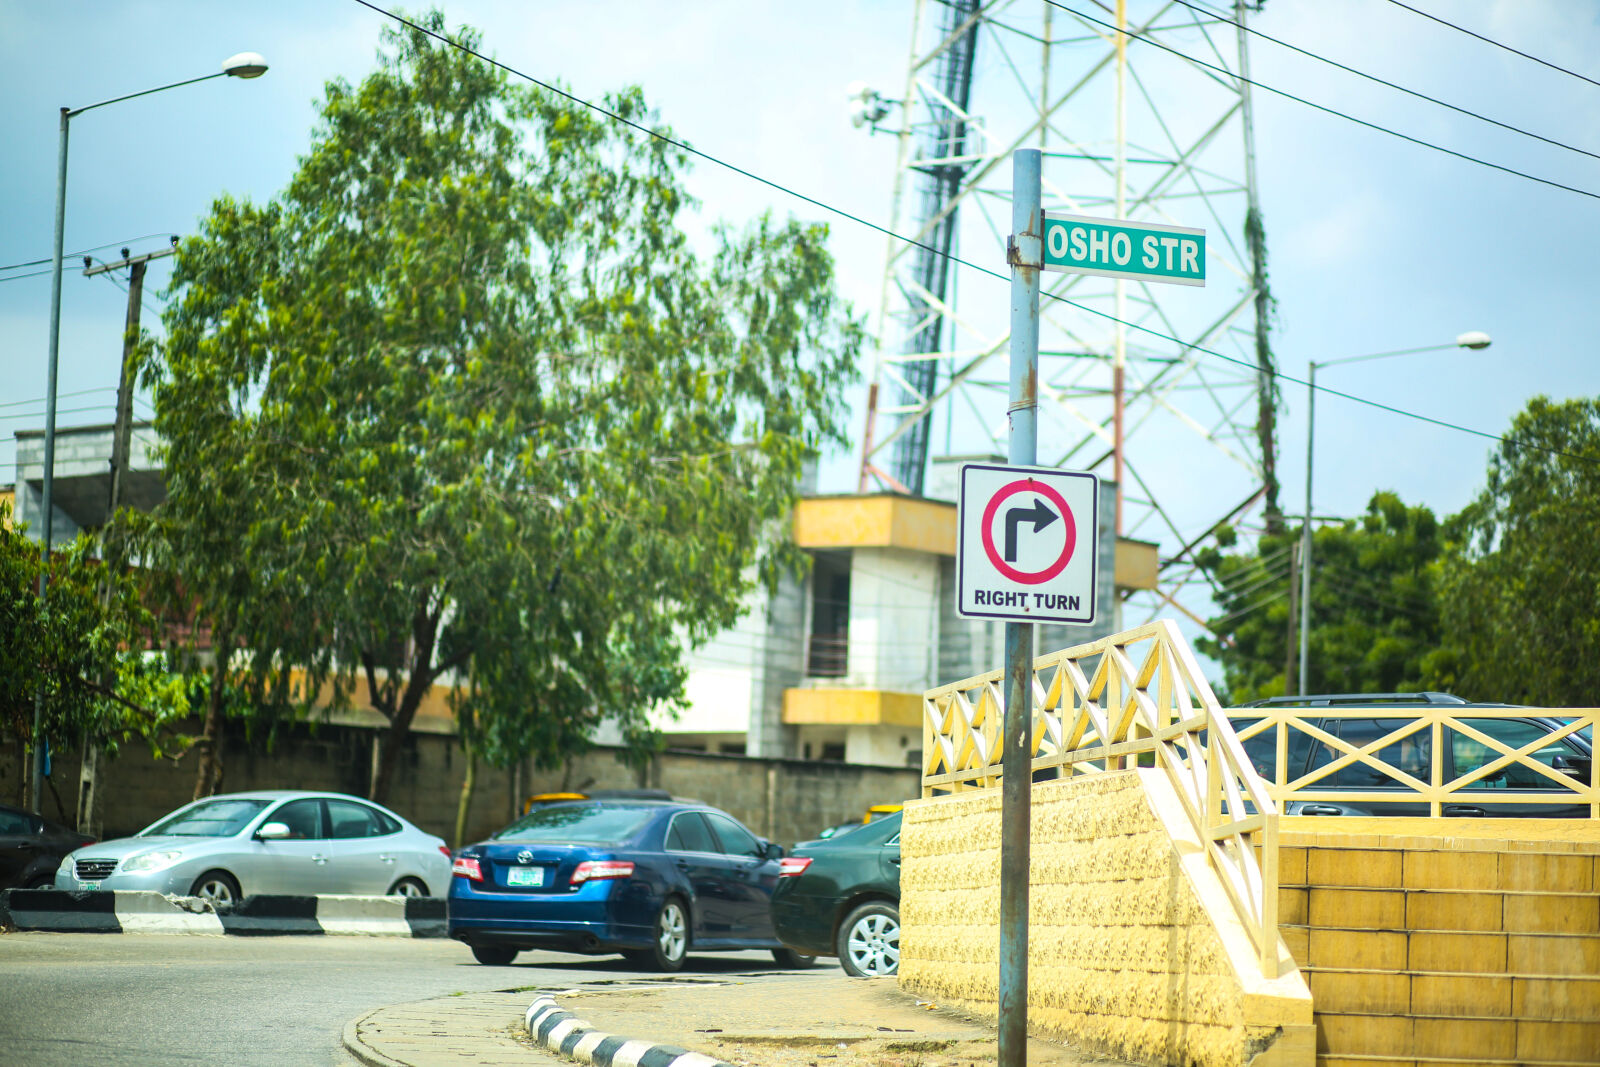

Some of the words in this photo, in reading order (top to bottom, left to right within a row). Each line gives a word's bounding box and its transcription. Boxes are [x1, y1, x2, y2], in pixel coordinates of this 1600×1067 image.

[1048, 225, 1132, 266] OSHO
[1142, 235, 1200, 273] STR
[975, 590, 1028, 607] RIGHT
[1033, 593, 1080, 611] TURN
